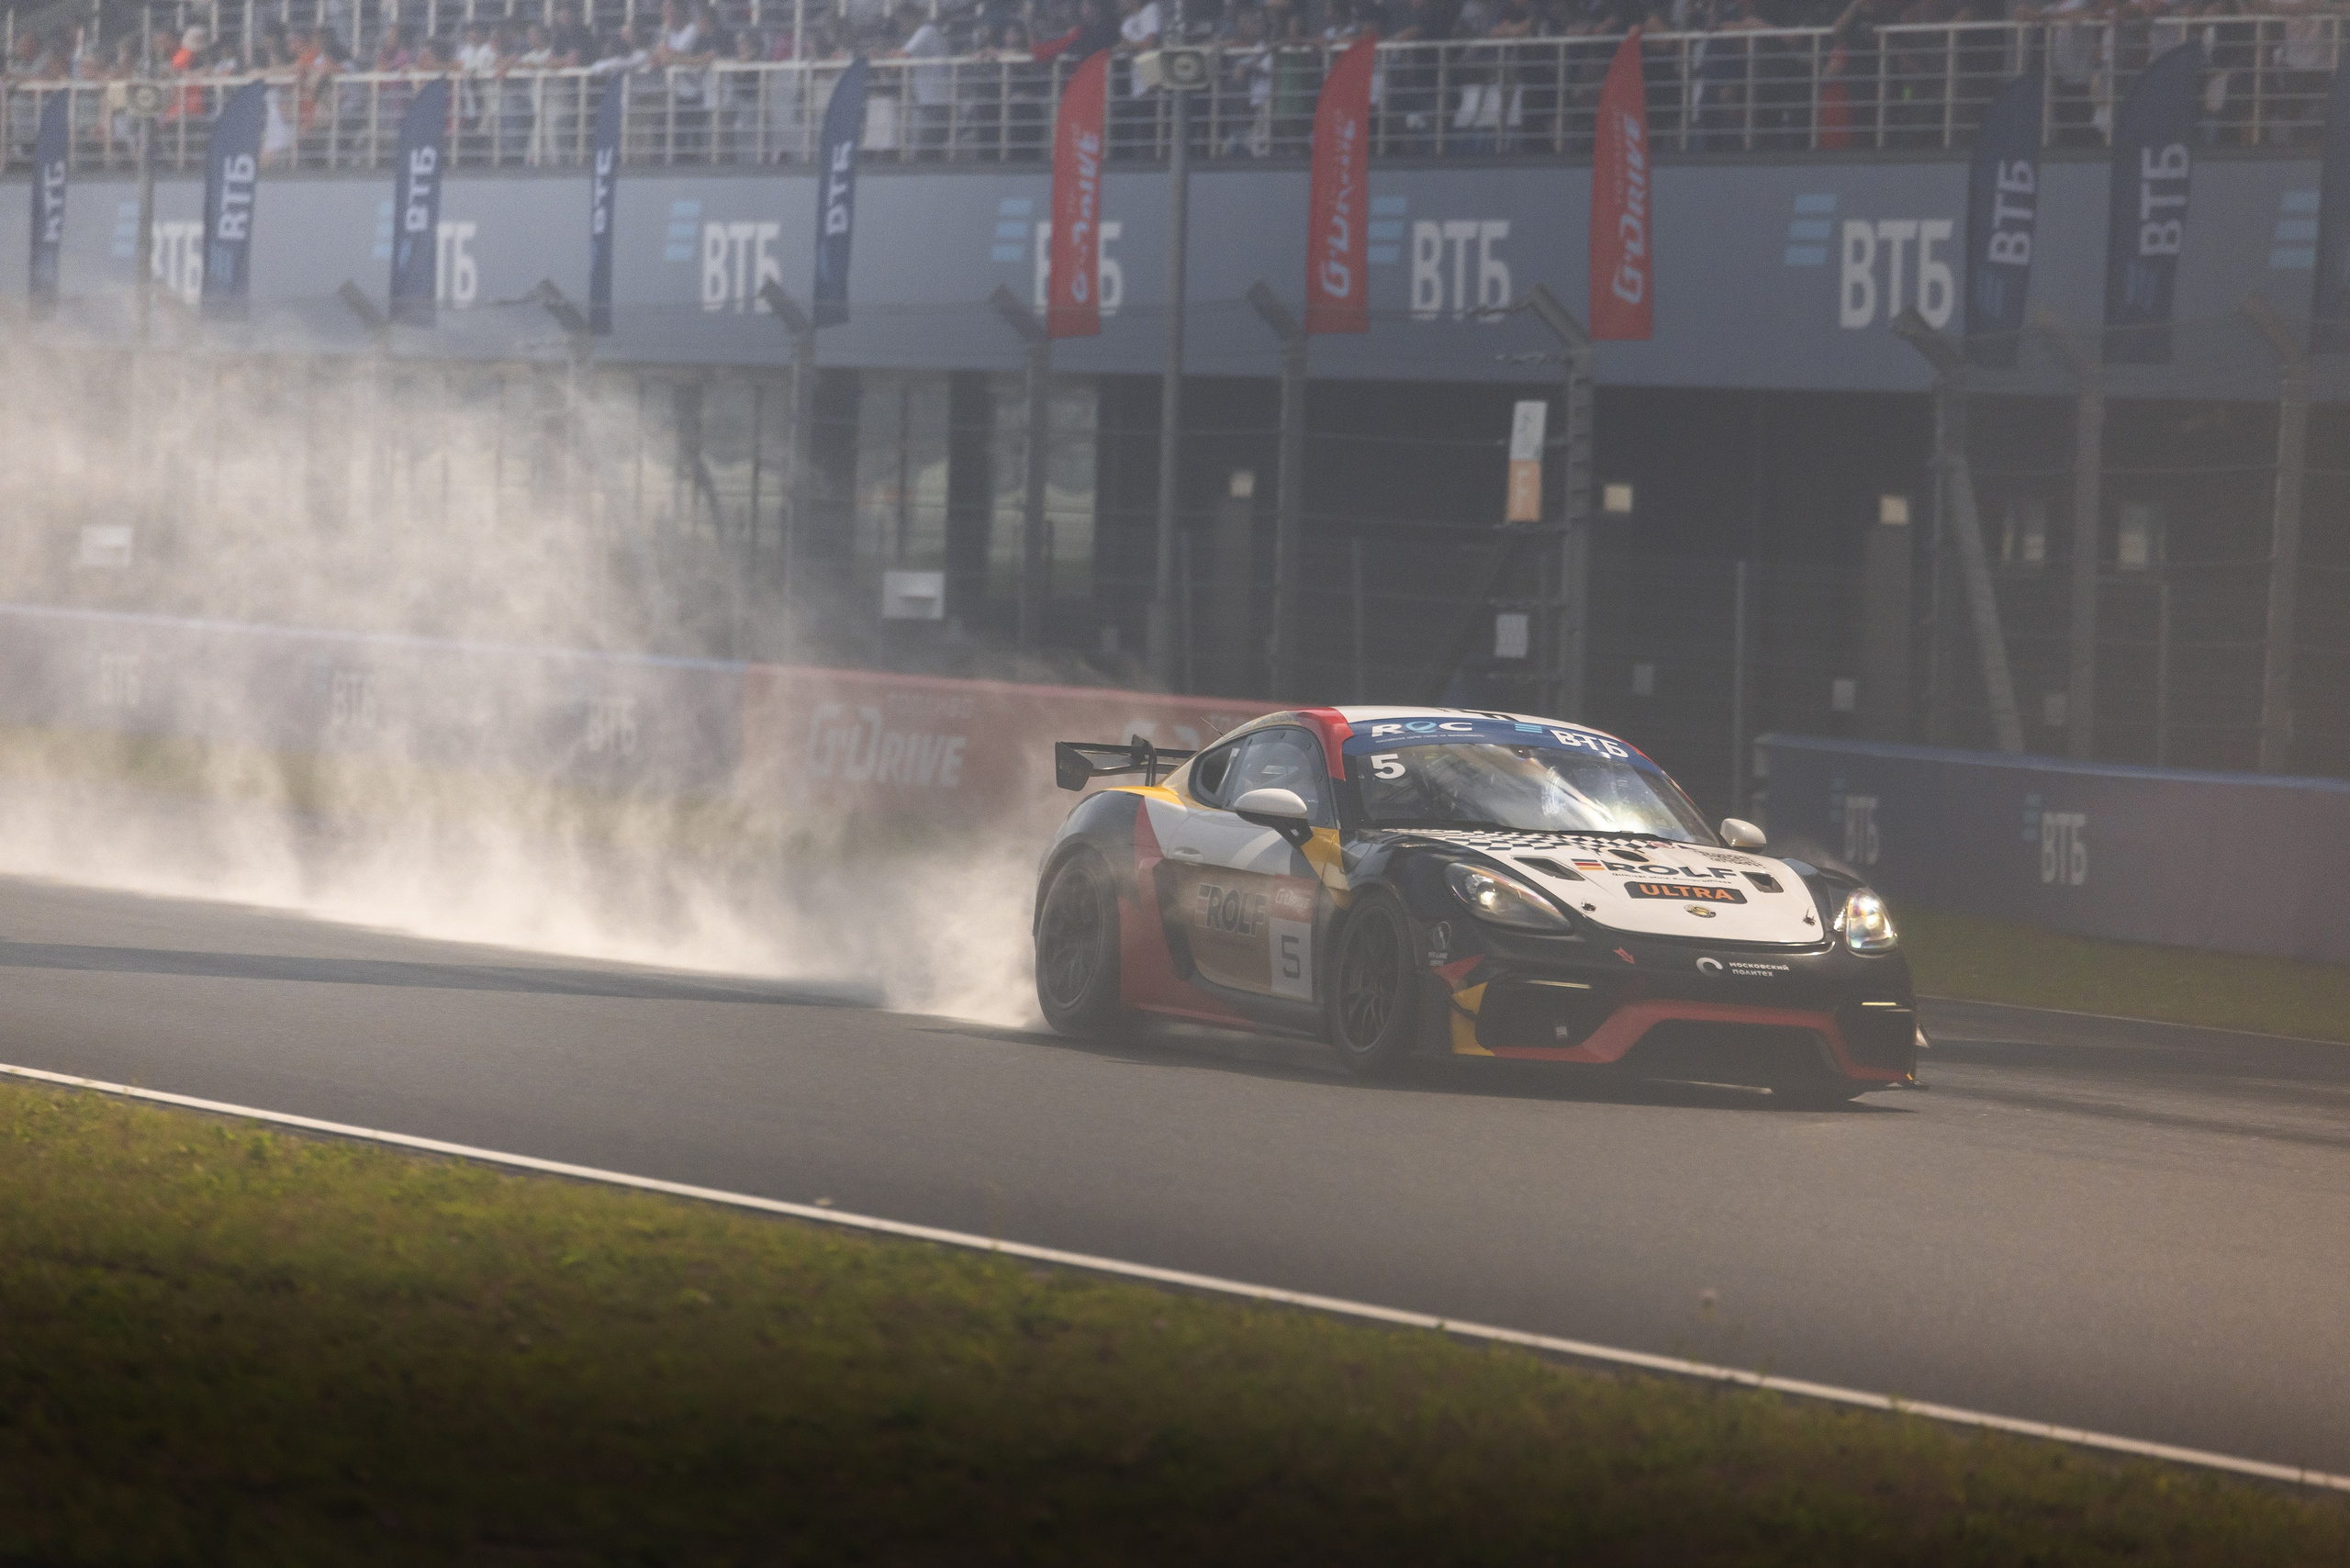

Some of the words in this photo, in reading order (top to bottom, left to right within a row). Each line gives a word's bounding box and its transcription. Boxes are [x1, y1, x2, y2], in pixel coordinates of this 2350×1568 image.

[1987, 160, 2035, 265] ВТБ
[2139, 142, 2189, 256] ВТБ
[701, 221, 780, 313] ВТБ
[1410, 218, 1512, 322] ВТБ
[1840, 218, 1953, 330] ВТБ
[1371, 754, 1405, 779] 5
[1550, 730, 1628, 758] ВТБ
[1845, 796, 1879, 865] ВТБ
[2042, 812, 2087, 886] ВТБ
[1601, 860, 1737, 879] ROLF
[1639, 883, 1734, 901] ULTRA
[1205, 884, 1270, 936] ROLF
[1281, 935, 1301, 980] 5
